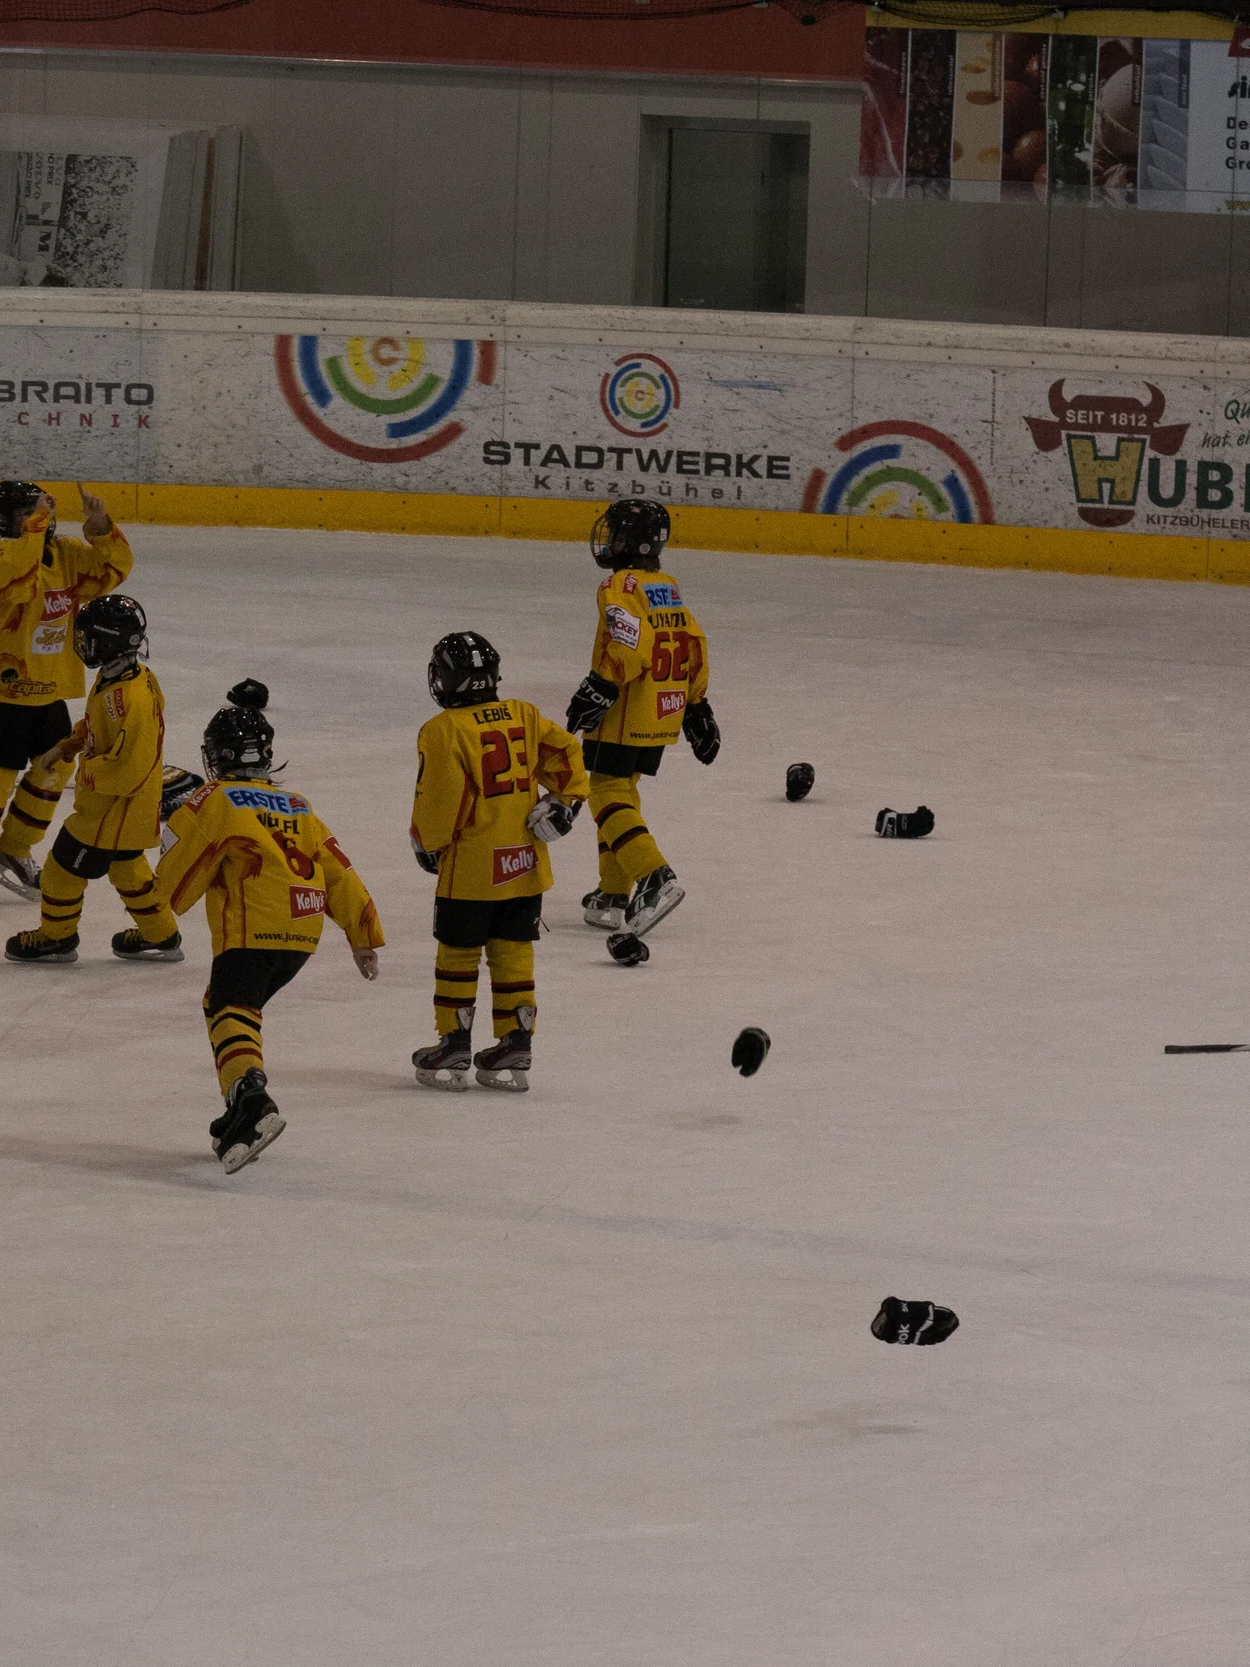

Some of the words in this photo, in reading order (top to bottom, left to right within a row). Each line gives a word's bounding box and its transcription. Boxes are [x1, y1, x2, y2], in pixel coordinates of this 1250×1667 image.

[1065, 409, 1104, 425] SEIT
[1109, 411, 1148, 428] 1812
[483, 440, 791, 480] STADTWERKE
[1065, 431, 1250, 513] HUB
[534, 473, 743, 501] Kitzbühel
[1145, 513, 1250, 530] KITZBÜHELER
[651, 631, 690, 682] 62
[471, 680, 487, 690] 23
[480, 726, 530, 798] 23
[228, 790, 290, 814] ERSTE
[295, 891, 326, 911] Kelly's
